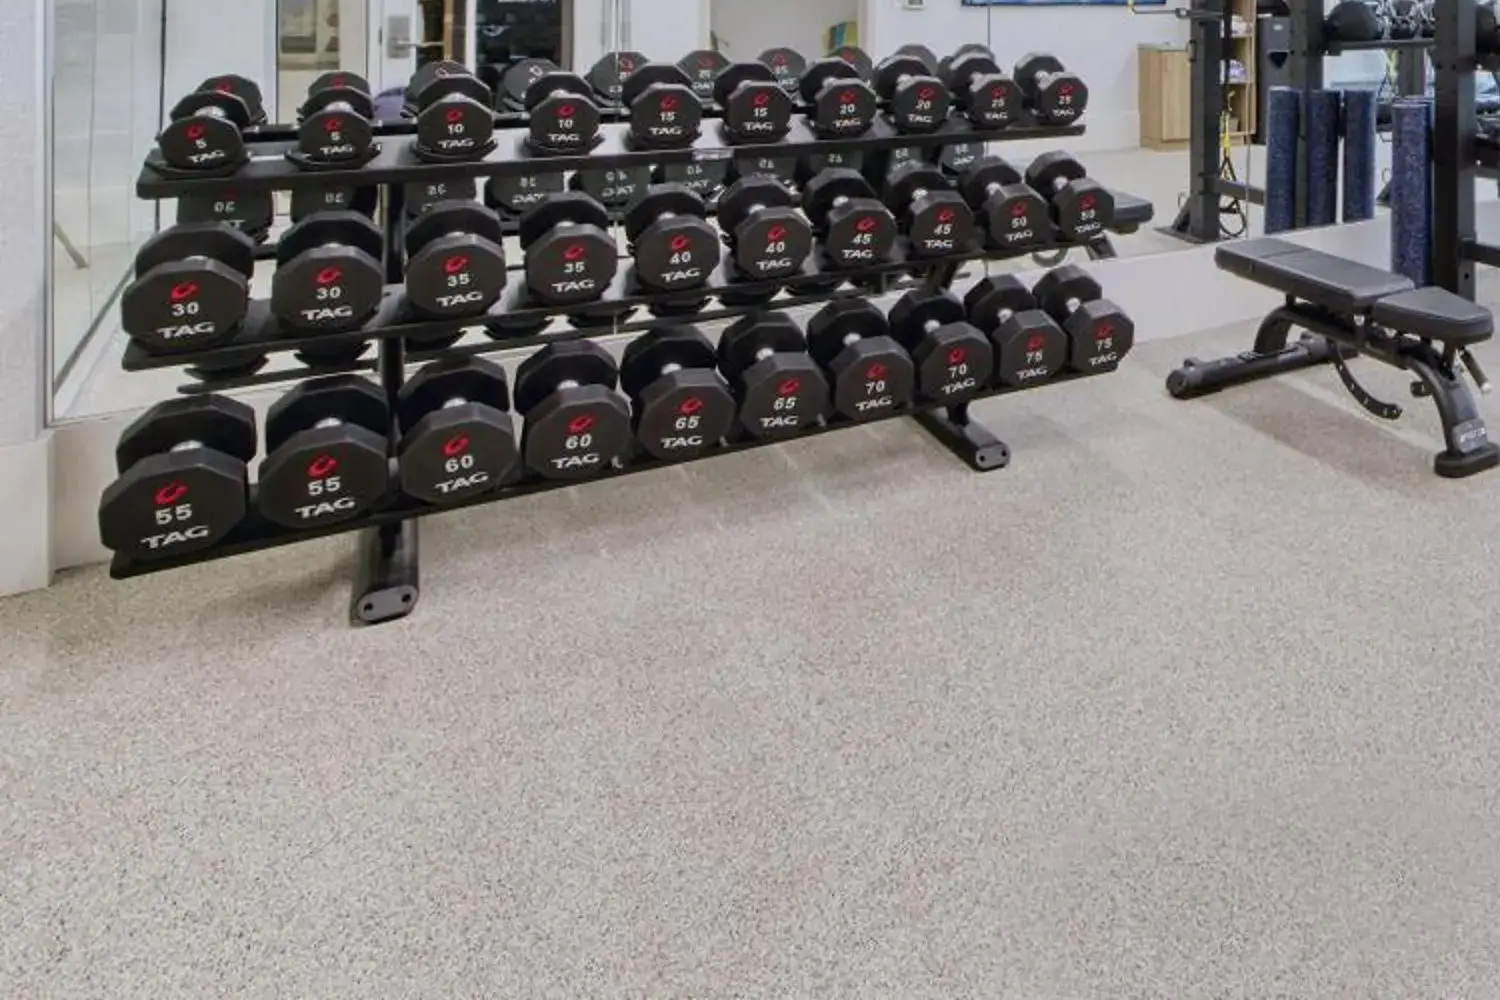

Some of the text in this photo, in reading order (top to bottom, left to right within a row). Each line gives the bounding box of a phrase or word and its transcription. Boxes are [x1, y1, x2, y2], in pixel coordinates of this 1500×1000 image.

[752, 106, 768, 117] 15
[840, 103, 855, 114] 20
[659, 111, 676, 122] 15
[833, 117, 861, 127] TAG
[908, 113, 933, 123] TAG
[985, 111, 1008, 120] TAG
[447, 123, 464, 134] 10
[558, 118, 574, 129] 10
[744, 121, 775, 131] TAG
[548, 132, 580, 142] TAG
[650, 126, 682, 135] TAG
[438, 137, 475, 149] TAG
[188, 150, 225, 163] TAG
[320, 145, 353, 155] TAG
[1011, 217, 1027, 229] 50
[933, 224, 951, 236] 45
[1005, 229, 1034, 243] TAG
[853, 233, 872, 245] 45
[924, 239, 953, 249] TAG
[766, 241, 786, 253] 40
[670, 252, 691, 265] 40
[842, 249, 873, 259] TAG
[564, 262, 585, 273] 35
[756, 258, 792, 270] TAG
[447, 273, 470, 287] 35
[660, 267, 701, 282] TAG
[552, 279, 595, 293] TAG
[316, 287, 341, 299] 30
[436, 291, 484, 307] TAG
[172, 302, 199, 316] 30
[301, 305, 353, 320] TAG
[157, 321, 216, 340] TAG
[1096, 337, 1113, 349] 75
[1088, 352, 1118, 366] TAG
[948, 364, 967, 378] 70
[1015, 365, 1049, 380] TAG
[865, 380, 885, 395] 70
[941, 377, 976, 394] TAG
[773, 397, 796, 410] 65
[855, 395, 893, 412] TAG
[675, 416, 701, 430] 65
[759, 415, 799, 428] TAG
[565, 433, 592, 450] 60
[661, 434, 703, 448] TAG
[445, 454, 474, 473] 60
[551, 453, 600, 469] TAG
[307, 476, 341, 496] 55
[435, 471, 489, 493] TAG
[155, 503, 193, 525] 55
[294, 497, 356, 518] TAG
[141, 525, 210, 549] TAG
